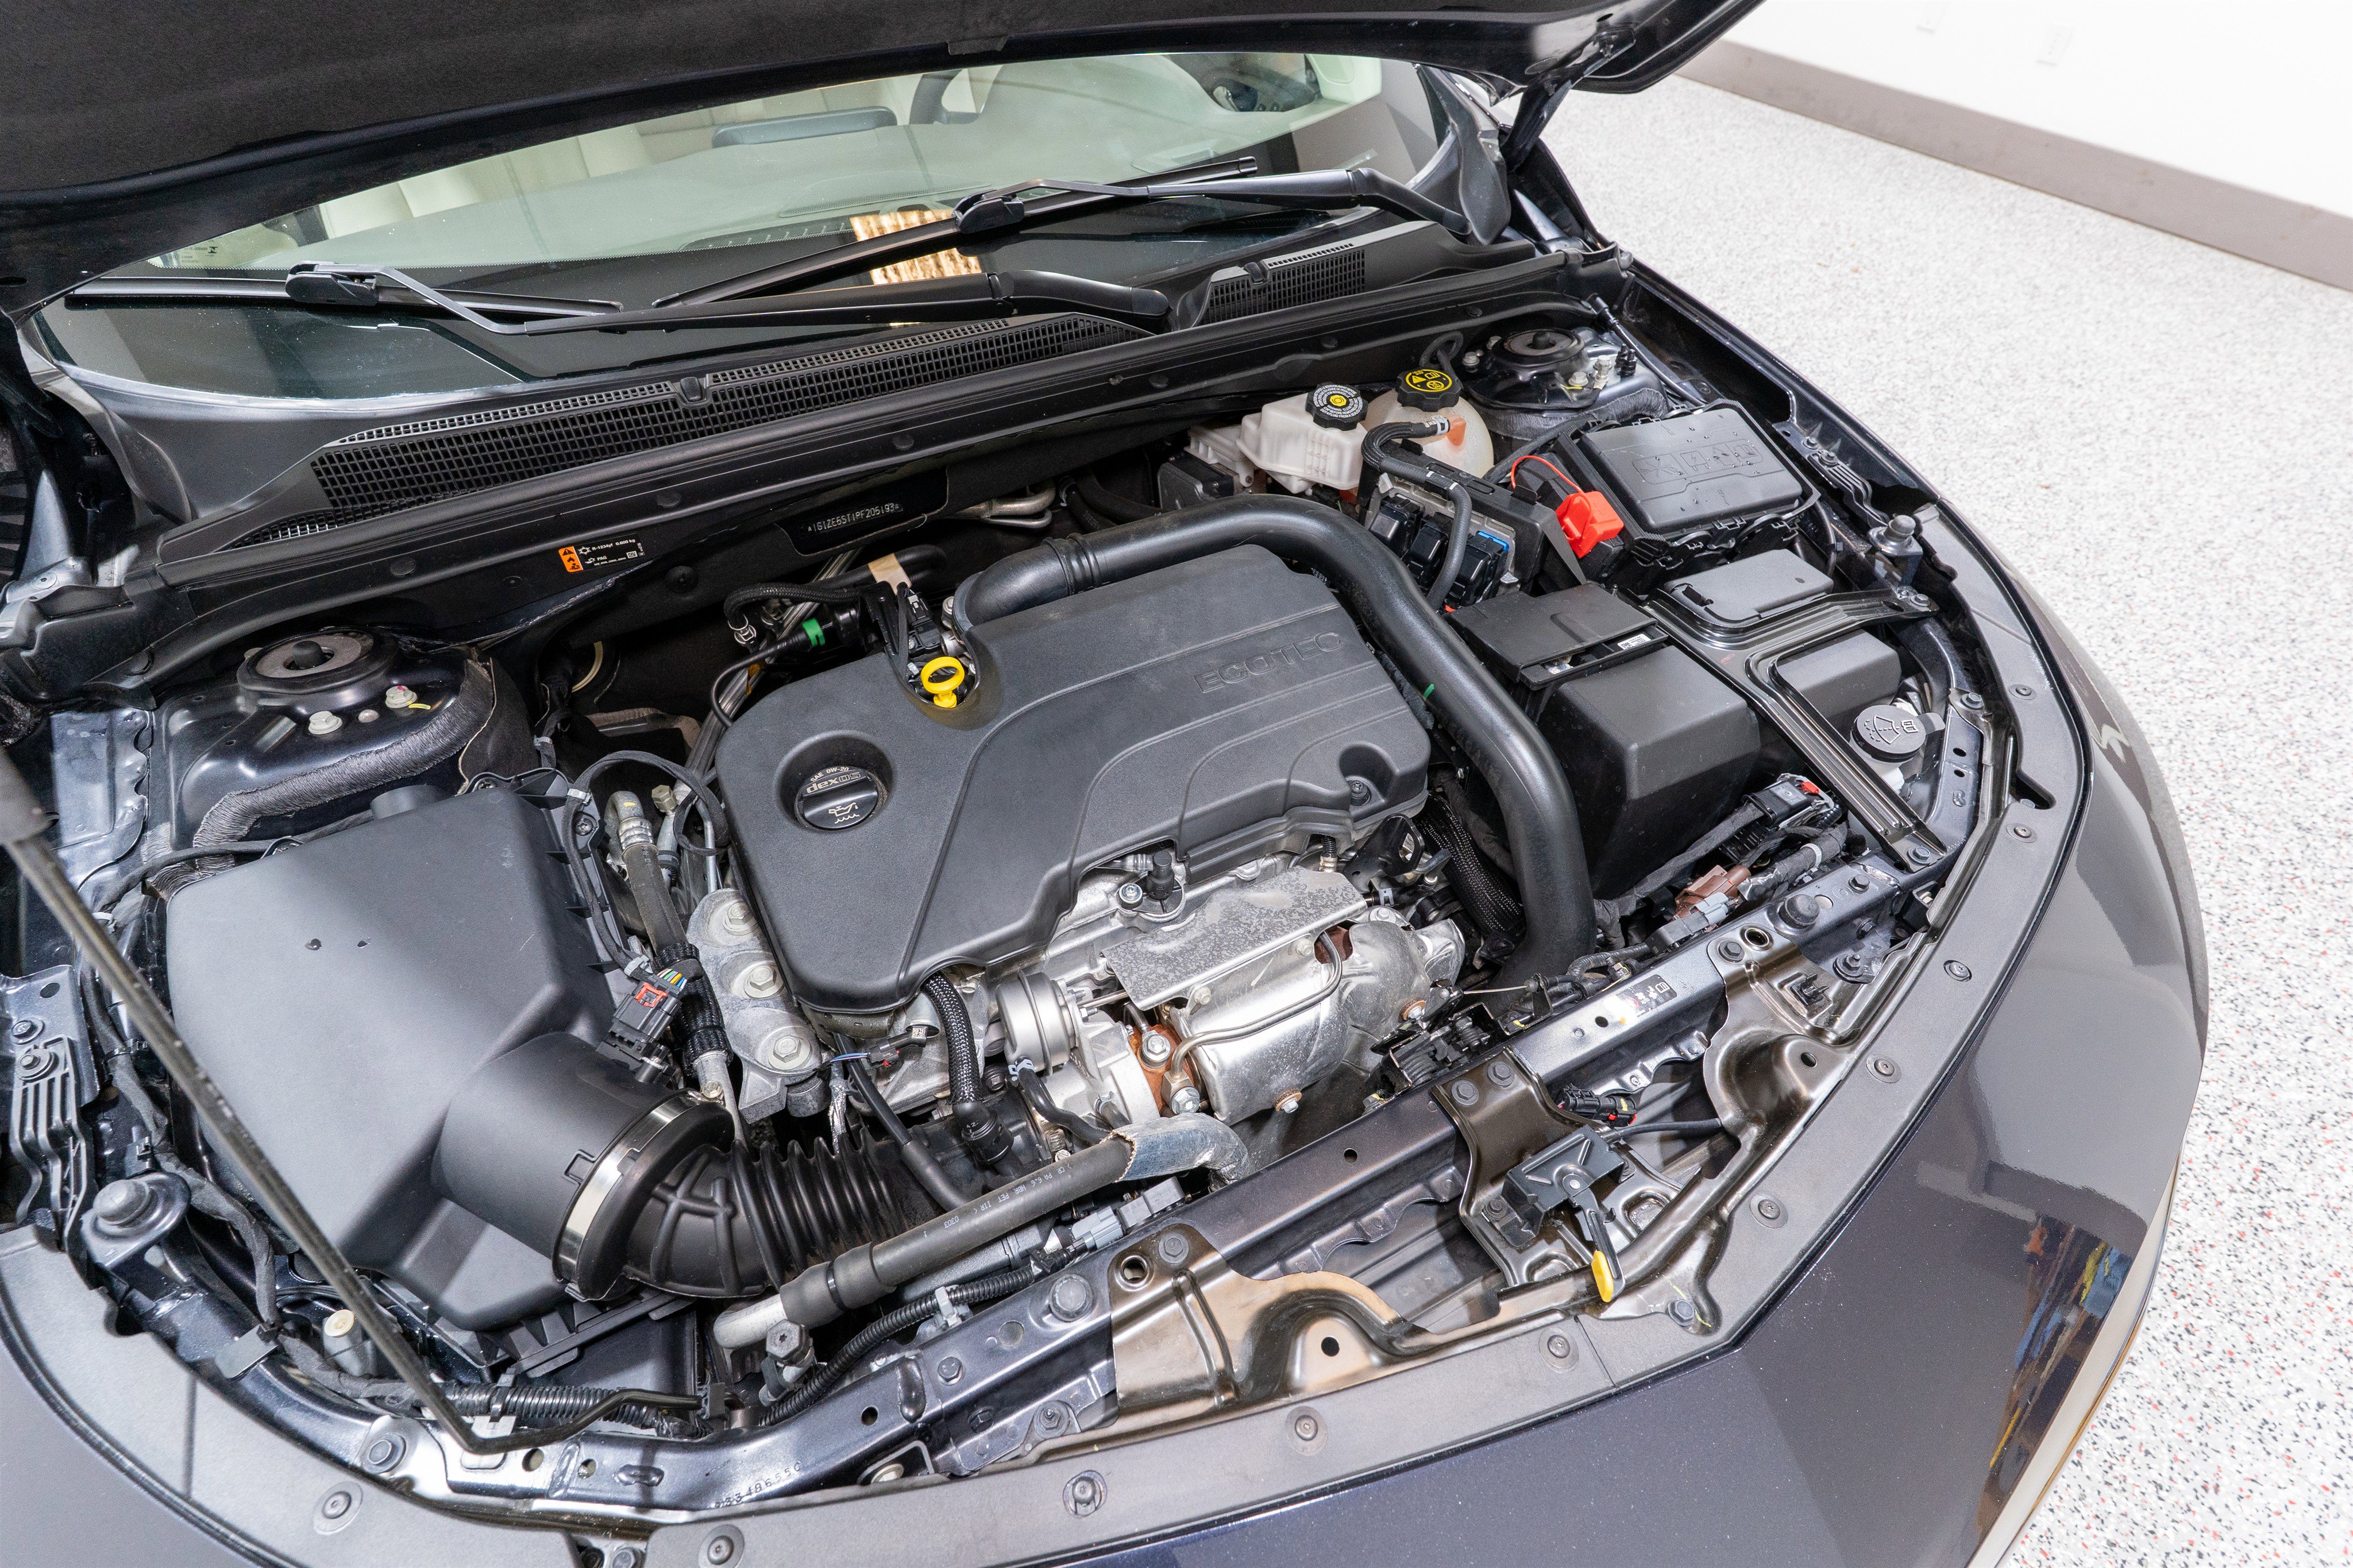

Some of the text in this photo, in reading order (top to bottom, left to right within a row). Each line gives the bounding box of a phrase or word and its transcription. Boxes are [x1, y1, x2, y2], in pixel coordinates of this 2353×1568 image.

[1193, 632, 1341, 693] ECOTEC
[806, 772, 861, 793] dexos
[810, 772, 824, 782] SAE
[1013, 1184, 1027, 1195] NBR
[998, 1192, 1009, 1203] PET
[944, 1216, 960, 1229] 0303
